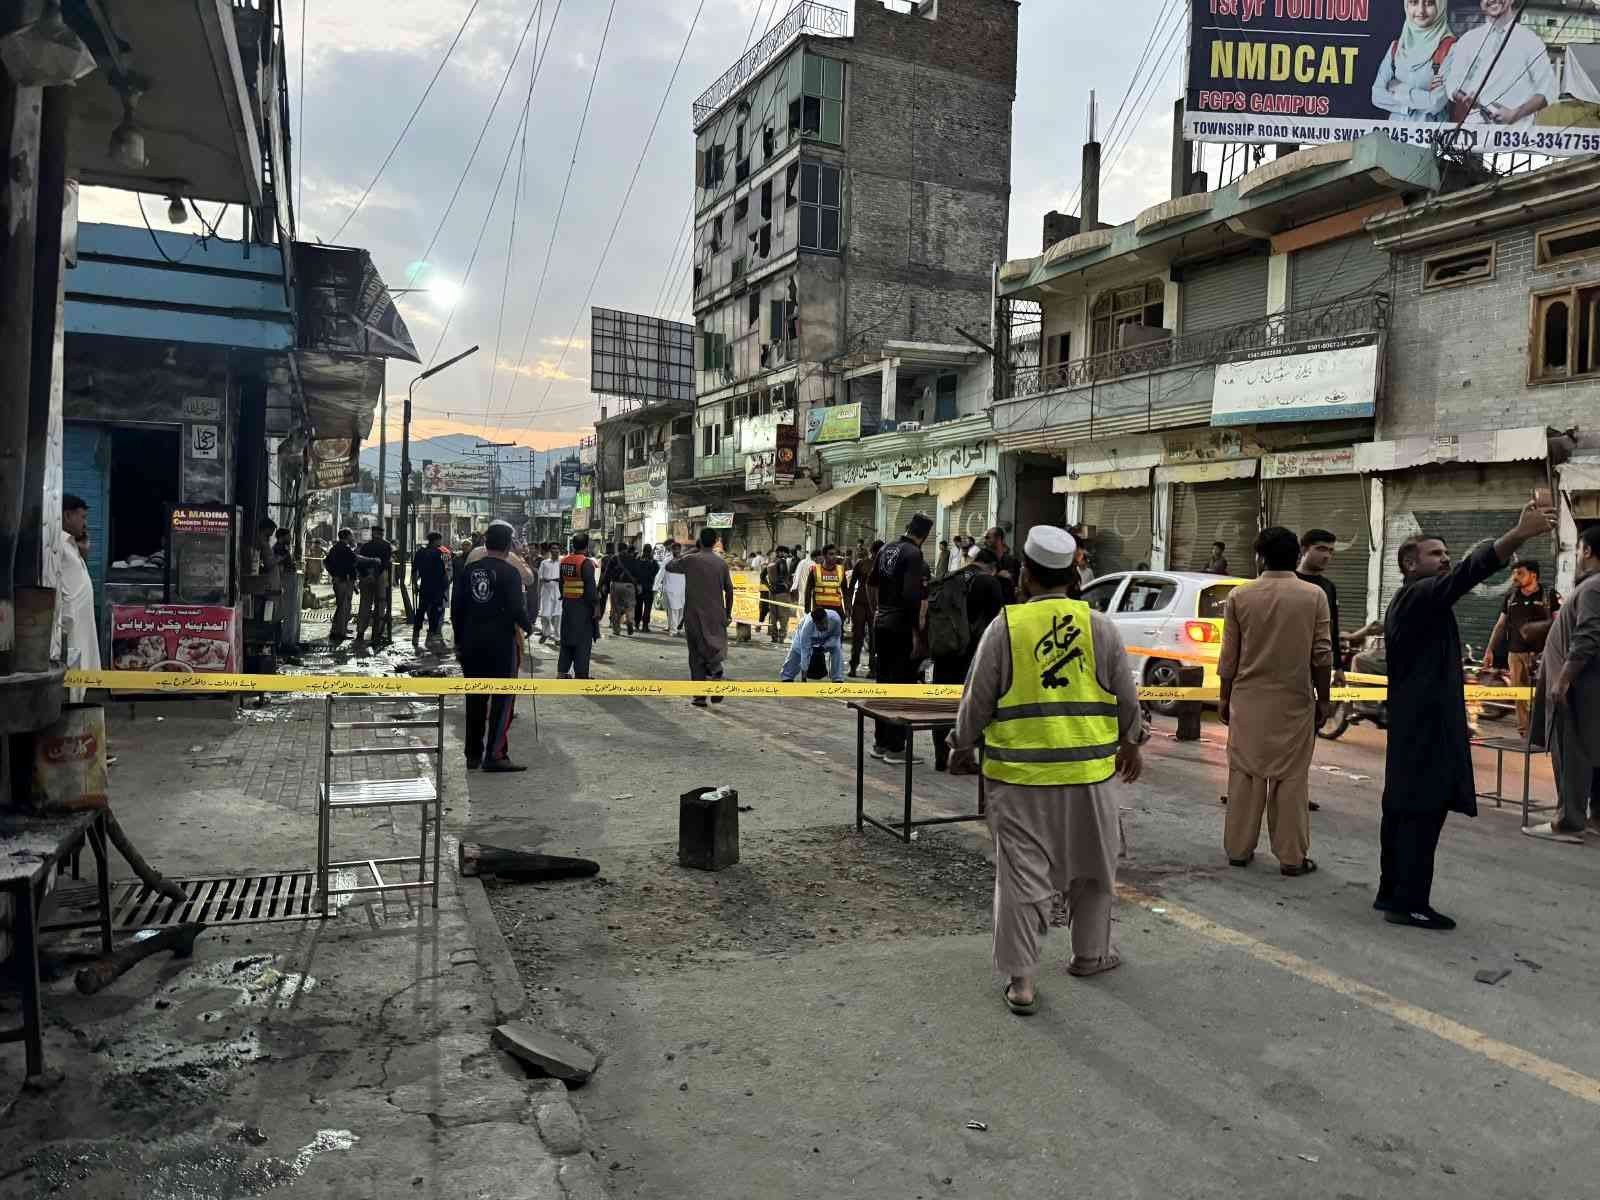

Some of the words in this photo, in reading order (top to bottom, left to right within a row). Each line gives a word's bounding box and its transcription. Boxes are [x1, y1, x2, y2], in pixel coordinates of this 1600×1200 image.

[1274, 0, 1371, 21] TUITION
[1210, 40, 1359, 85] NMDCAT
[1199, 90, 1246, 111] FCPS
[1250, 94, 1329, 115] CAMPUS
[1193, 121, 1254, 137] TOWNSHIP
[1257, 124, 1288, 138] ROAD
[1291, 127, 1331, 140] KANJU
[1333, 129, 1366, 142] SWAT
[1494, 130, 1600, 151] 0334-3347755
[173, 510, 186, 519] AL
[188, 511, 229, 519] MADINA
